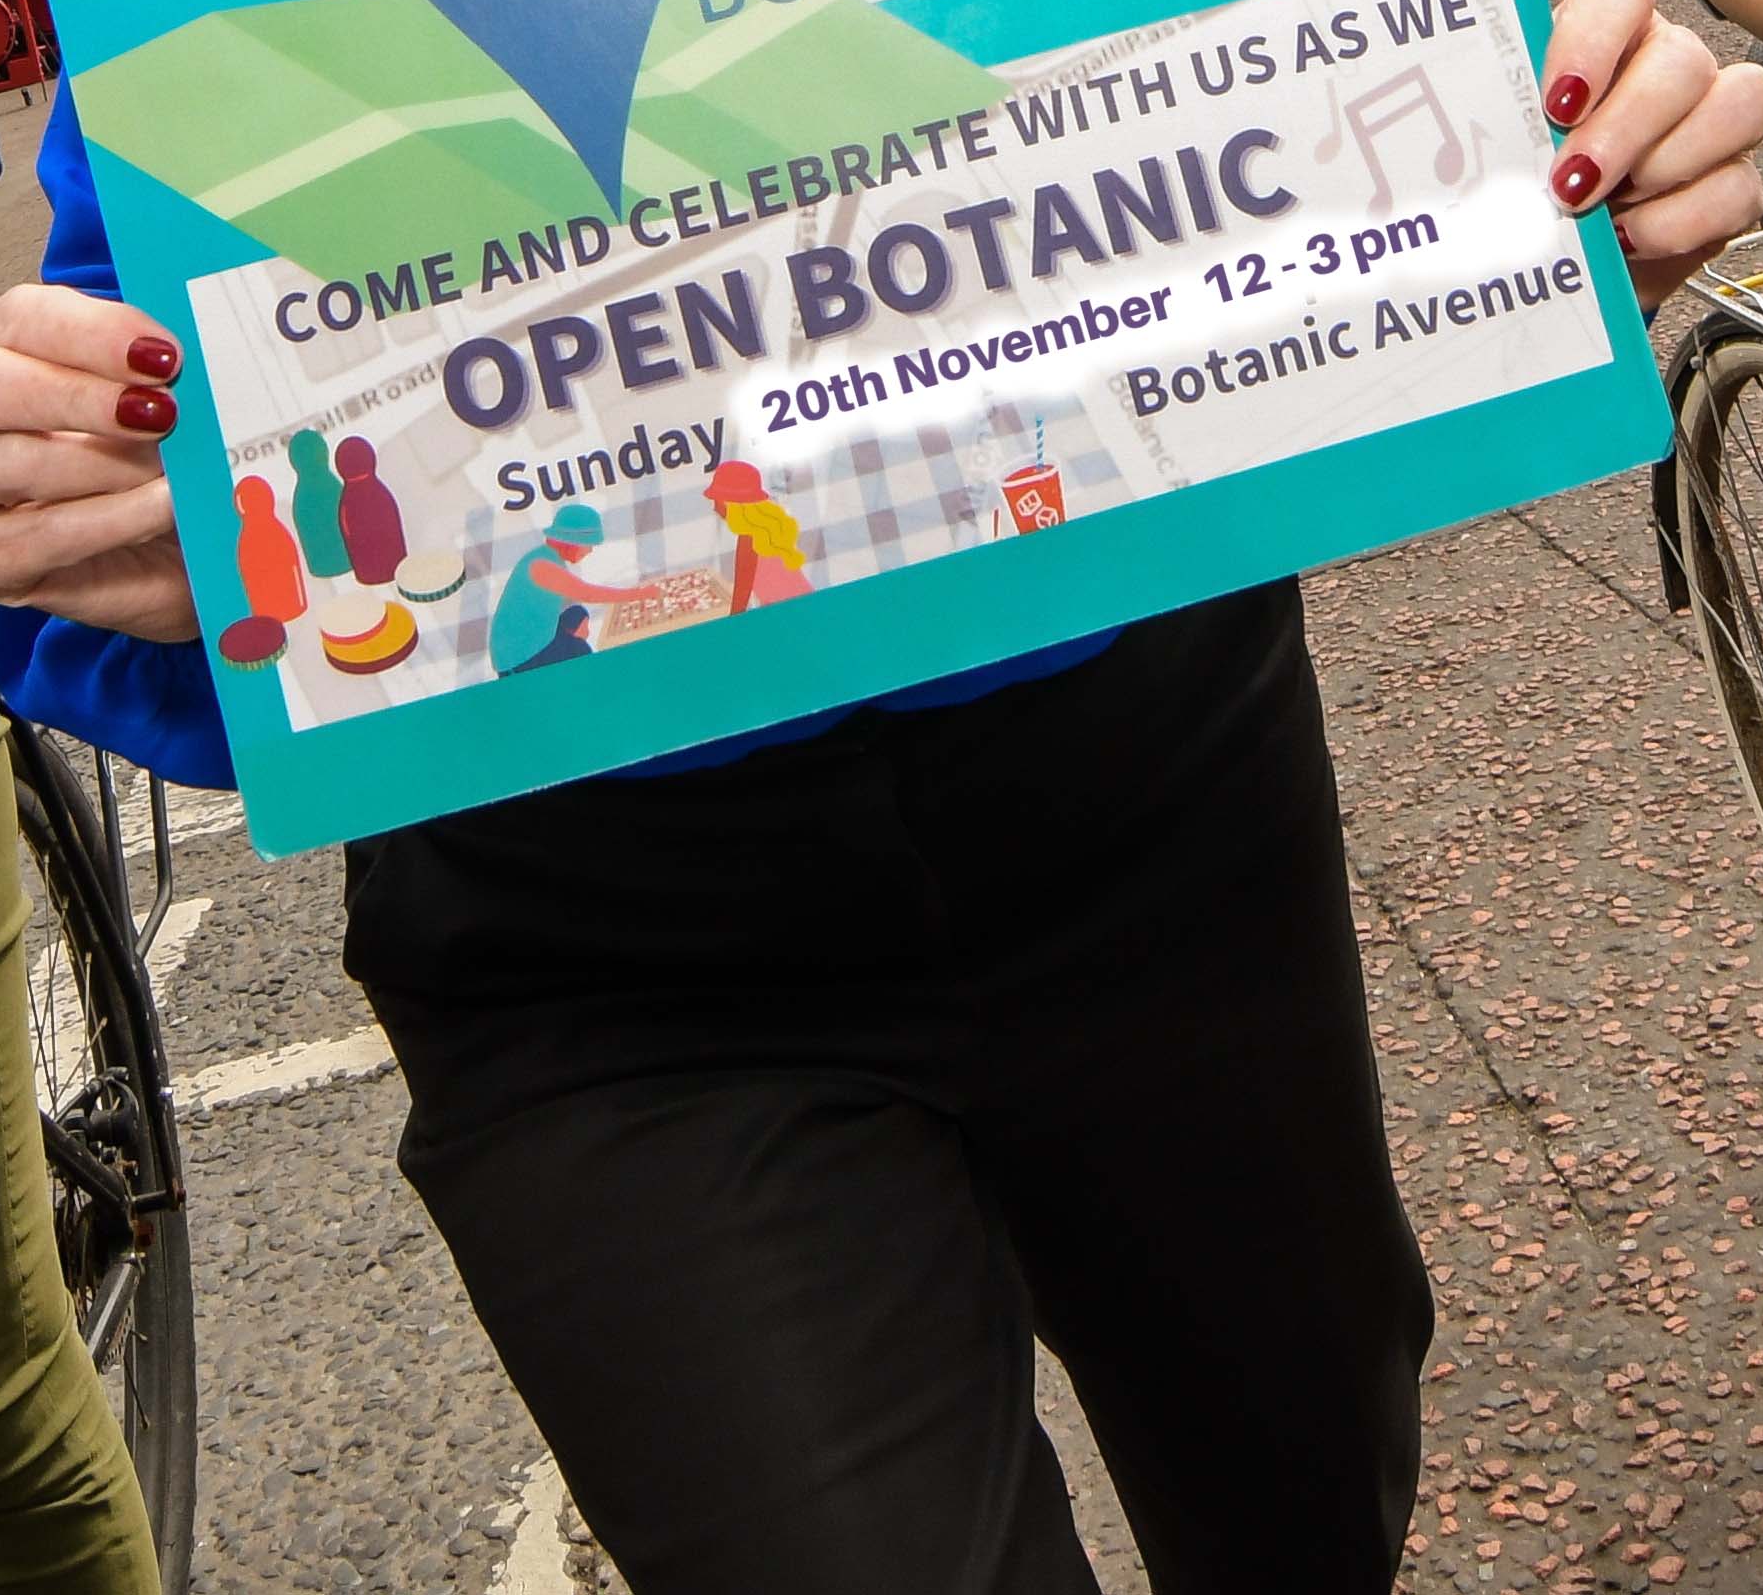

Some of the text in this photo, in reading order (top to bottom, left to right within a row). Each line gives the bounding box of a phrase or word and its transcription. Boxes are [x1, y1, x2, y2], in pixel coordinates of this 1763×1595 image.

[275, 252, 463, 344] COME
[480, 214, 610, 294] AND
[629, 110, 997, 248] CELEBRATE
[1006, 60, 1178, 148] WITH
[1189, 34, 1278, 97] US
[1293, 10, 1368, 76] AS
[442, 267, 768, 435] OPEN
[786, 126, 1299, 342] BOTANIC
[360, 362, 436, 410] Road
[497, 416, 726, 513] Sunday
[760, 364, 888, 434] 20th
[893, 284, 1172, 396] November
[1204, 253, 1272, 305] 12
[1306, 233, 1342, 277] 3
[1352, 212, 1440, 273] pm
[1126, 254, 1584, 418] Botanic Avenue
